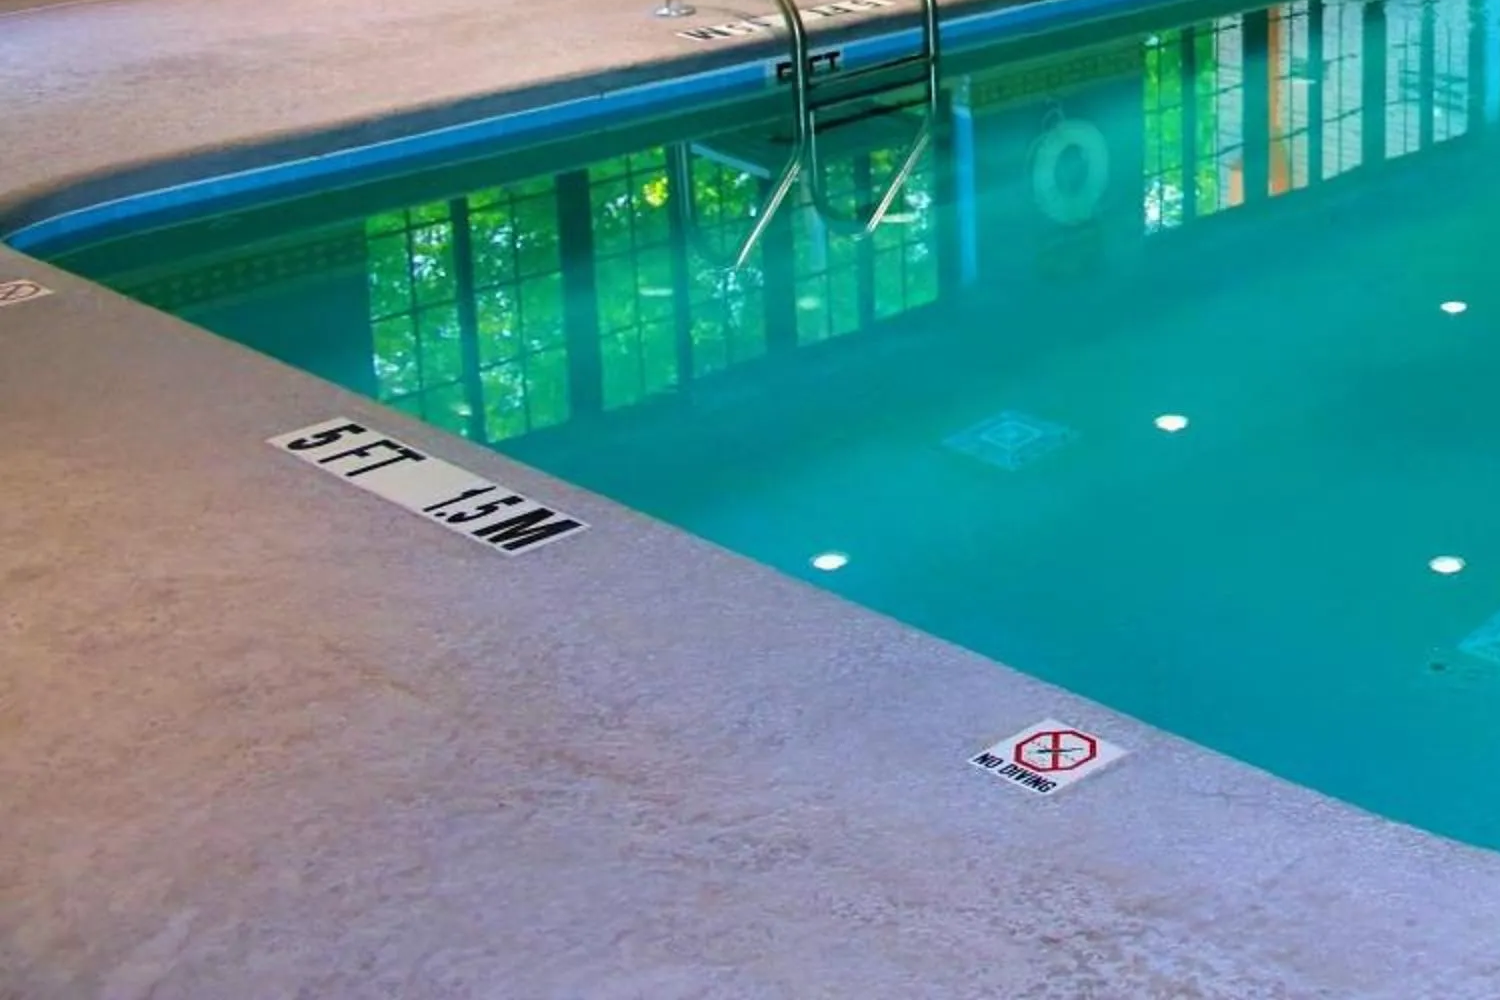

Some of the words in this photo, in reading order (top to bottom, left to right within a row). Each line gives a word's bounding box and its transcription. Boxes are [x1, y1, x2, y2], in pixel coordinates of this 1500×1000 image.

[287, 423, 366, 451] 5
[318, 438, 427, 477] FT
[973, 751, 1004, 769] NO
[998, 763, 1058, 793] DIVING
